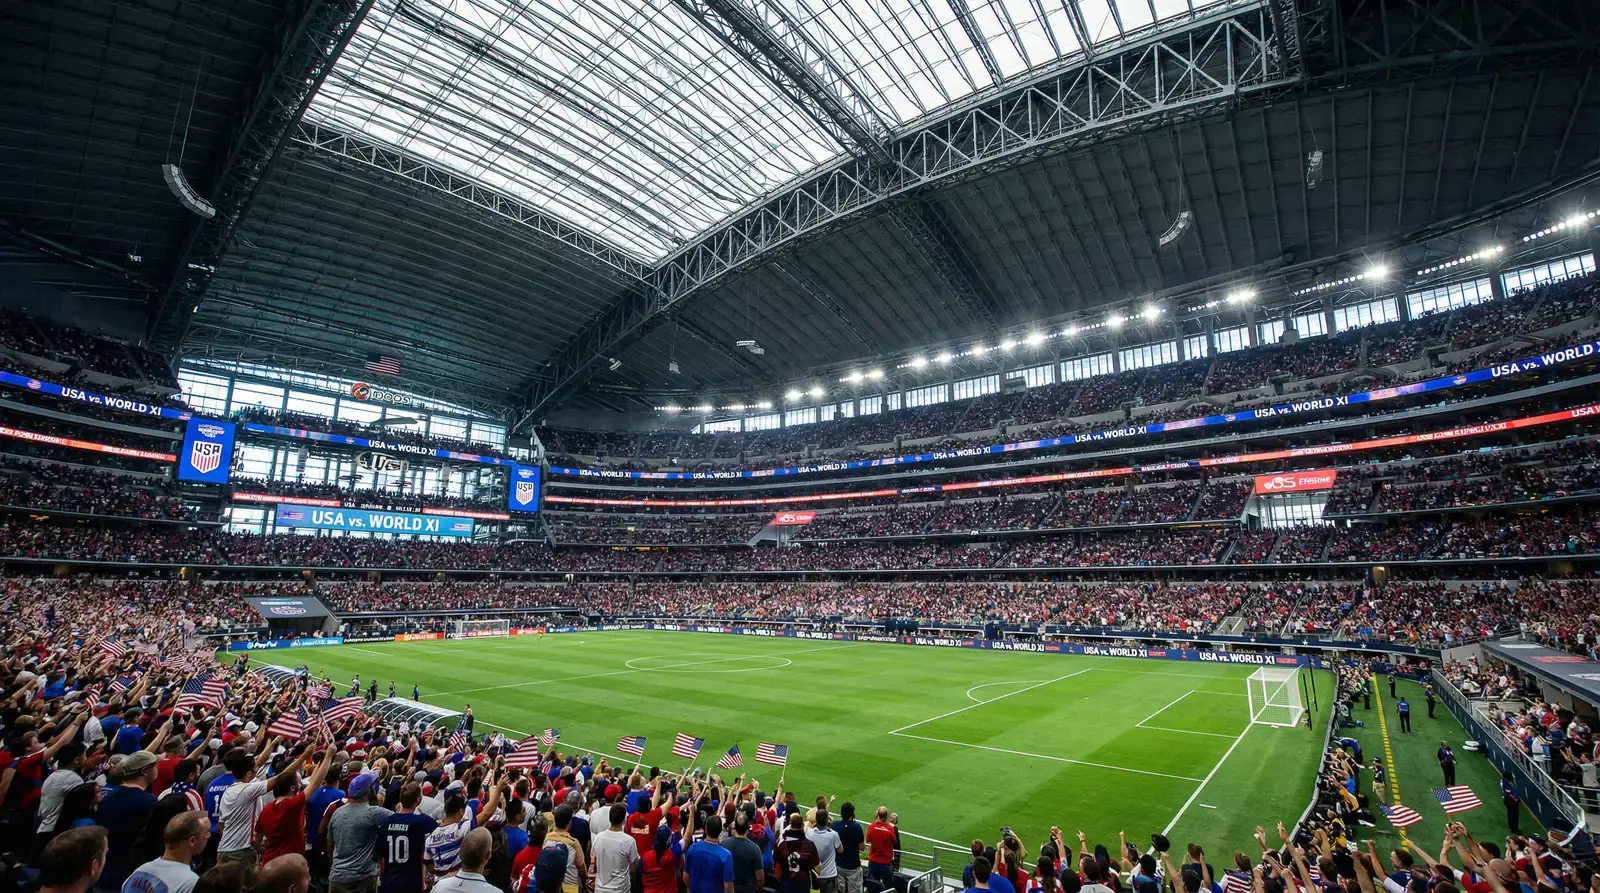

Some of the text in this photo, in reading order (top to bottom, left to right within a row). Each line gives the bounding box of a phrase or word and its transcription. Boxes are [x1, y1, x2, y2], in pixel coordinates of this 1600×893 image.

[1491, 363, 1520, 377] USA
[1522, 361, 1540, 370] vs.
[1541, 344, 1594, 366] WORLD
[62, 387, 161, 416] USA vs. WORLD XI
[1254, 395, 1349, 418] USA vs. WORLD XI
[1571, 406, 1594, 417] USA
[1075, 434, 1092, 443] USA
[1103, 427, 1136, 439] WORLD
[1137, 426, 1147, 434] XI
[195, 442, 220, 456] USA
[368, 440, 385, 449] USA
[397, 443, 427, 454] WORLD
[428, 448, 437, 456] XI
[933, 450, 948, 460] USA
[957, 448, 983, 457] WORLD
[983, 446, 991, 454] XI
[312, 510, 439, 533] USA vs. WORLD XI
[992, 641, 1005, 649] USA
[1013, 643, 1036, 651] WORLD
[1084, 646, 1098, 655] USA
[1109, 648, 1137, 657] WORLD
[1138, 649, 1147, 657] XI
[1200, 651, 1218, 661] USA
[1230, 653, 1263, 664] WORLD
[1265, 655, 1275, 664] XI
[387, 835, 409, 863] 10
